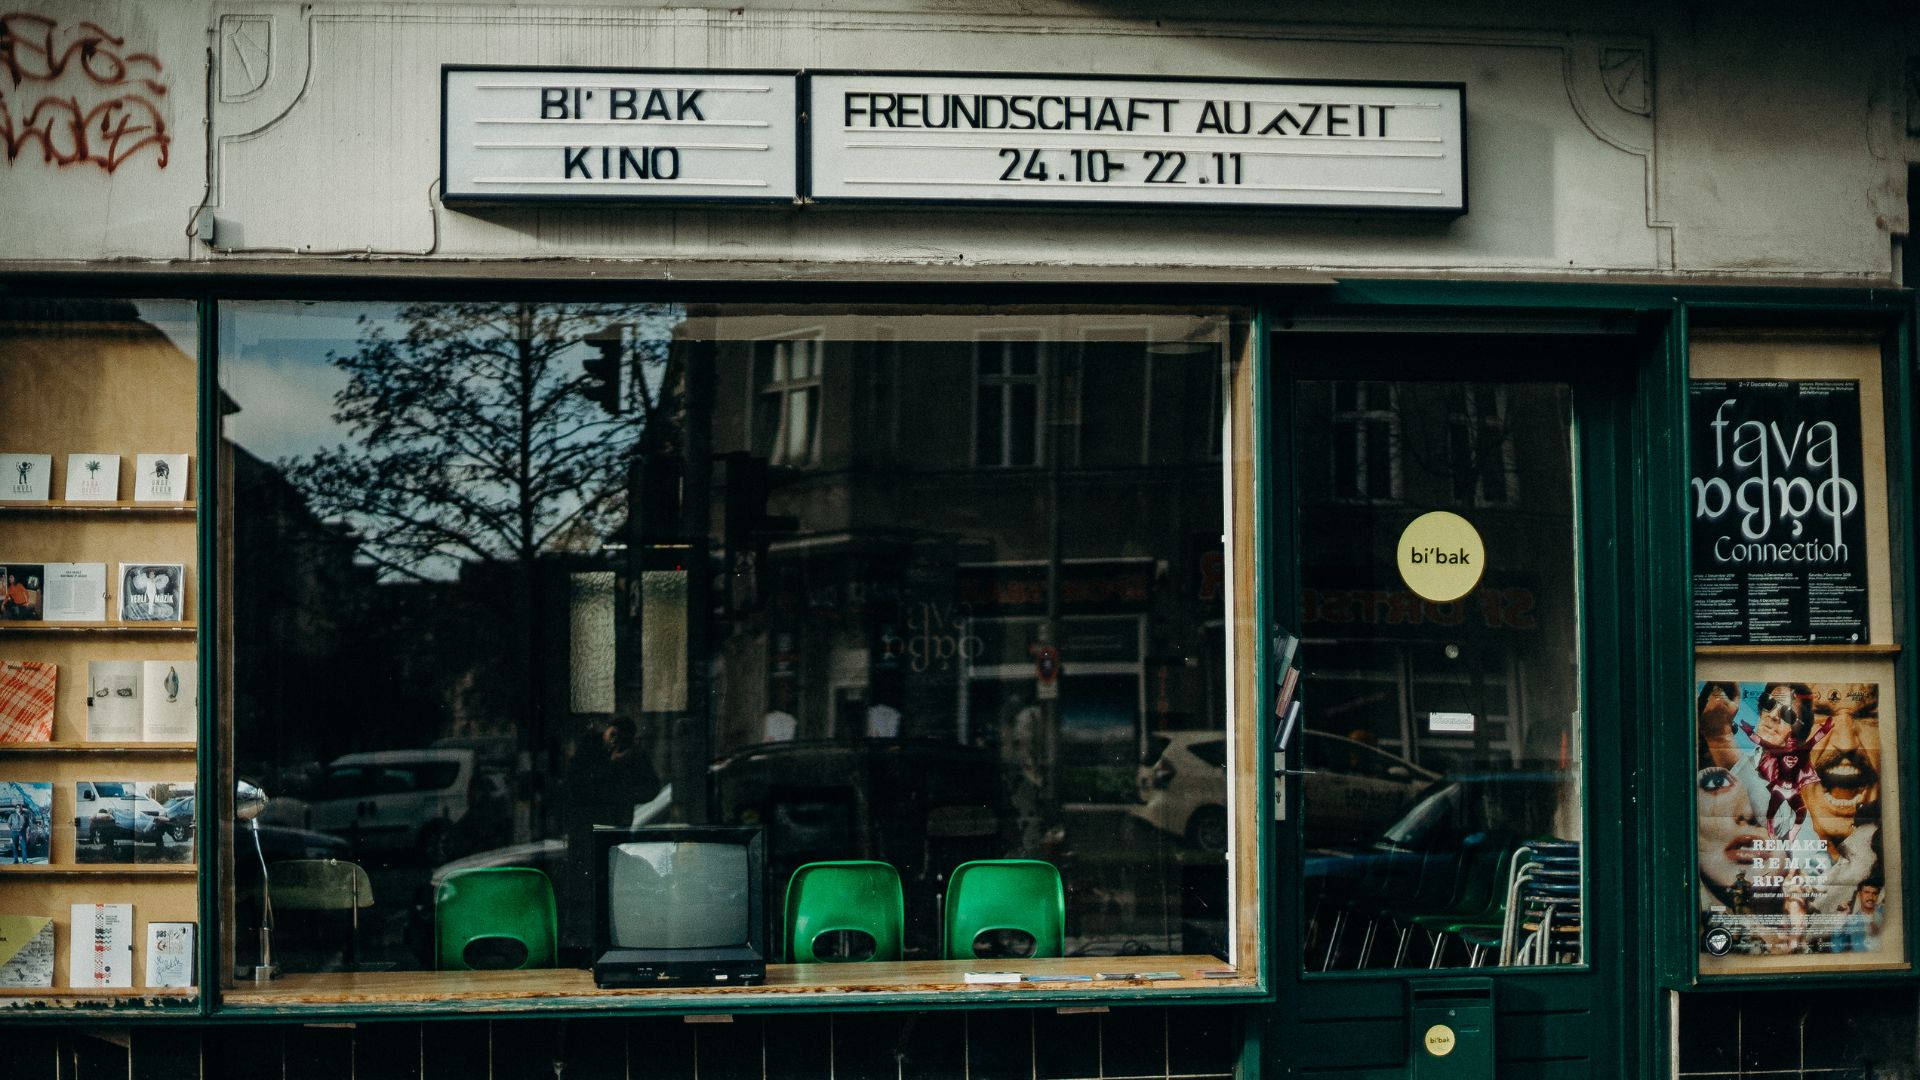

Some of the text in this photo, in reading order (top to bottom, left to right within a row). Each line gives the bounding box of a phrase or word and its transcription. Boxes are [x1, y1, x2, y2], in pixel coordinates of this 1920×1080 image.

[844, 91, 1180, 133] FREUNDSCHAFT
[564, 146, 680, 180] KINO
[1710, 399, 1838, 468] fava
[1411, 546, 1470, 565] bi'bak
[1714, 536, 1848, 562] Connection
[1752, 839, 1828, 851] REMAKE
[1752, 857, 1828, 869] REMIX
[1752, 875, 1785, 887] RIP
